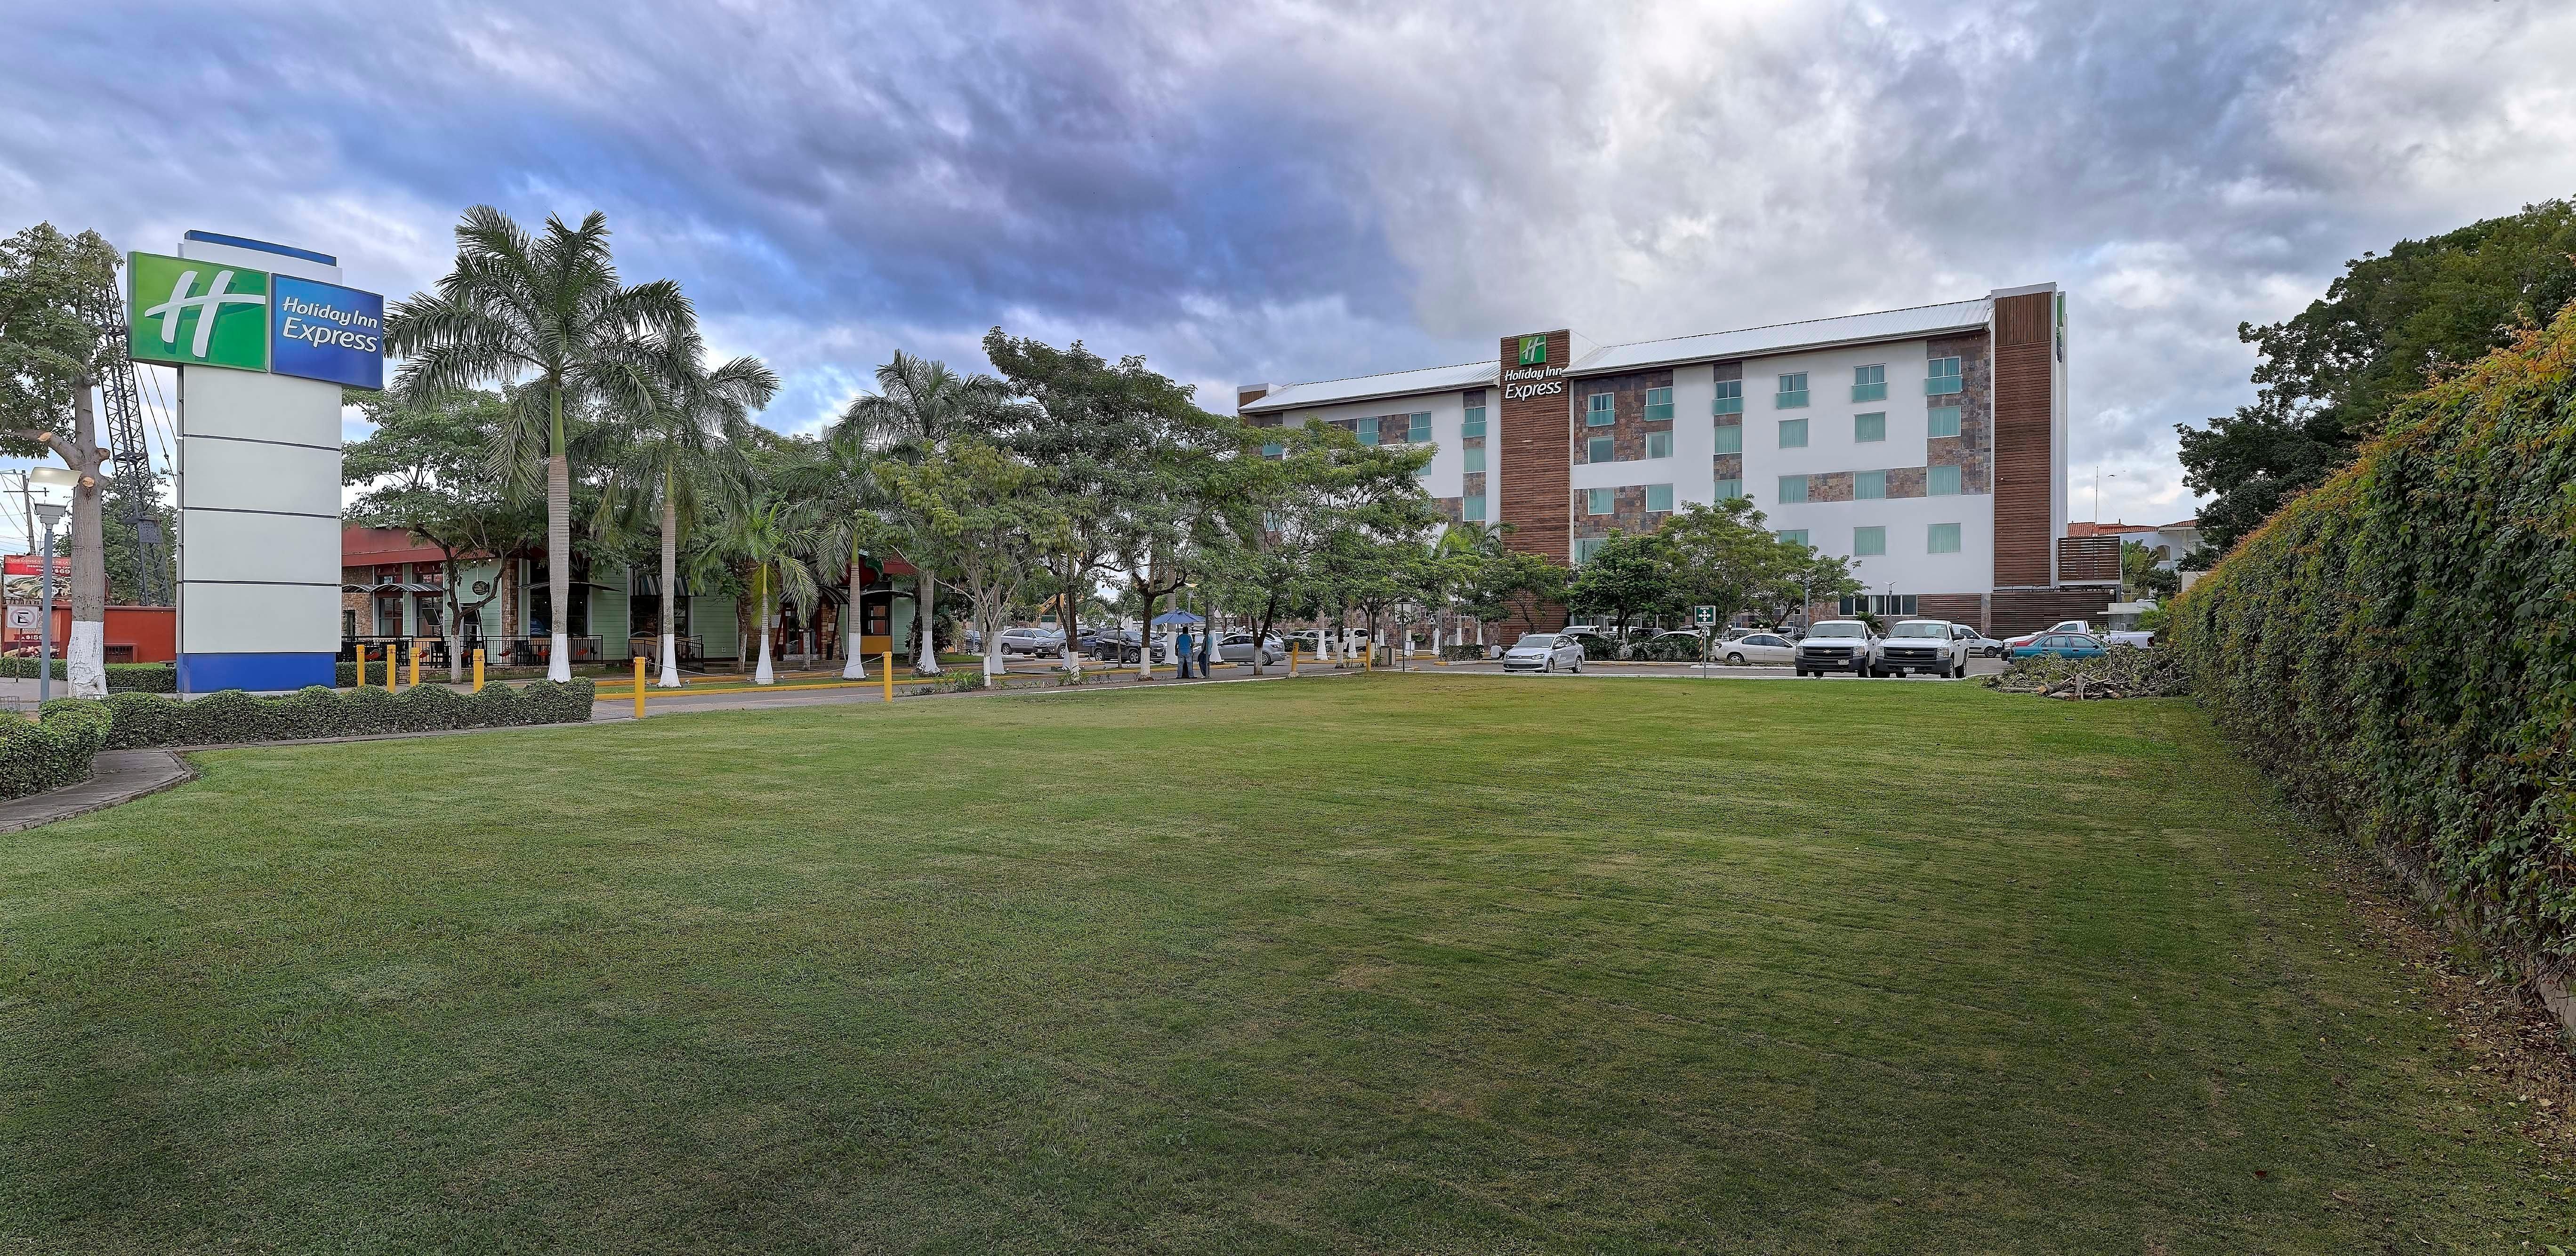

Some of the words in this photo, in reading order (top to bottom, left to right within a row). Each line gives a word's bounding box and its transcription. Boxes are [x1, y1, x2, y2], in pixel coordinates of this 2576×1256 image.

[282, 296, 351, 326] Holiday
[353, 310, 378, 329] Inn
[283, 316, 378, 352] Express
[1505, 367, 1544, 381] Holiday
[1546, 365, 1562, 377] Inn
[1505, 381, 1562, 401] Express
